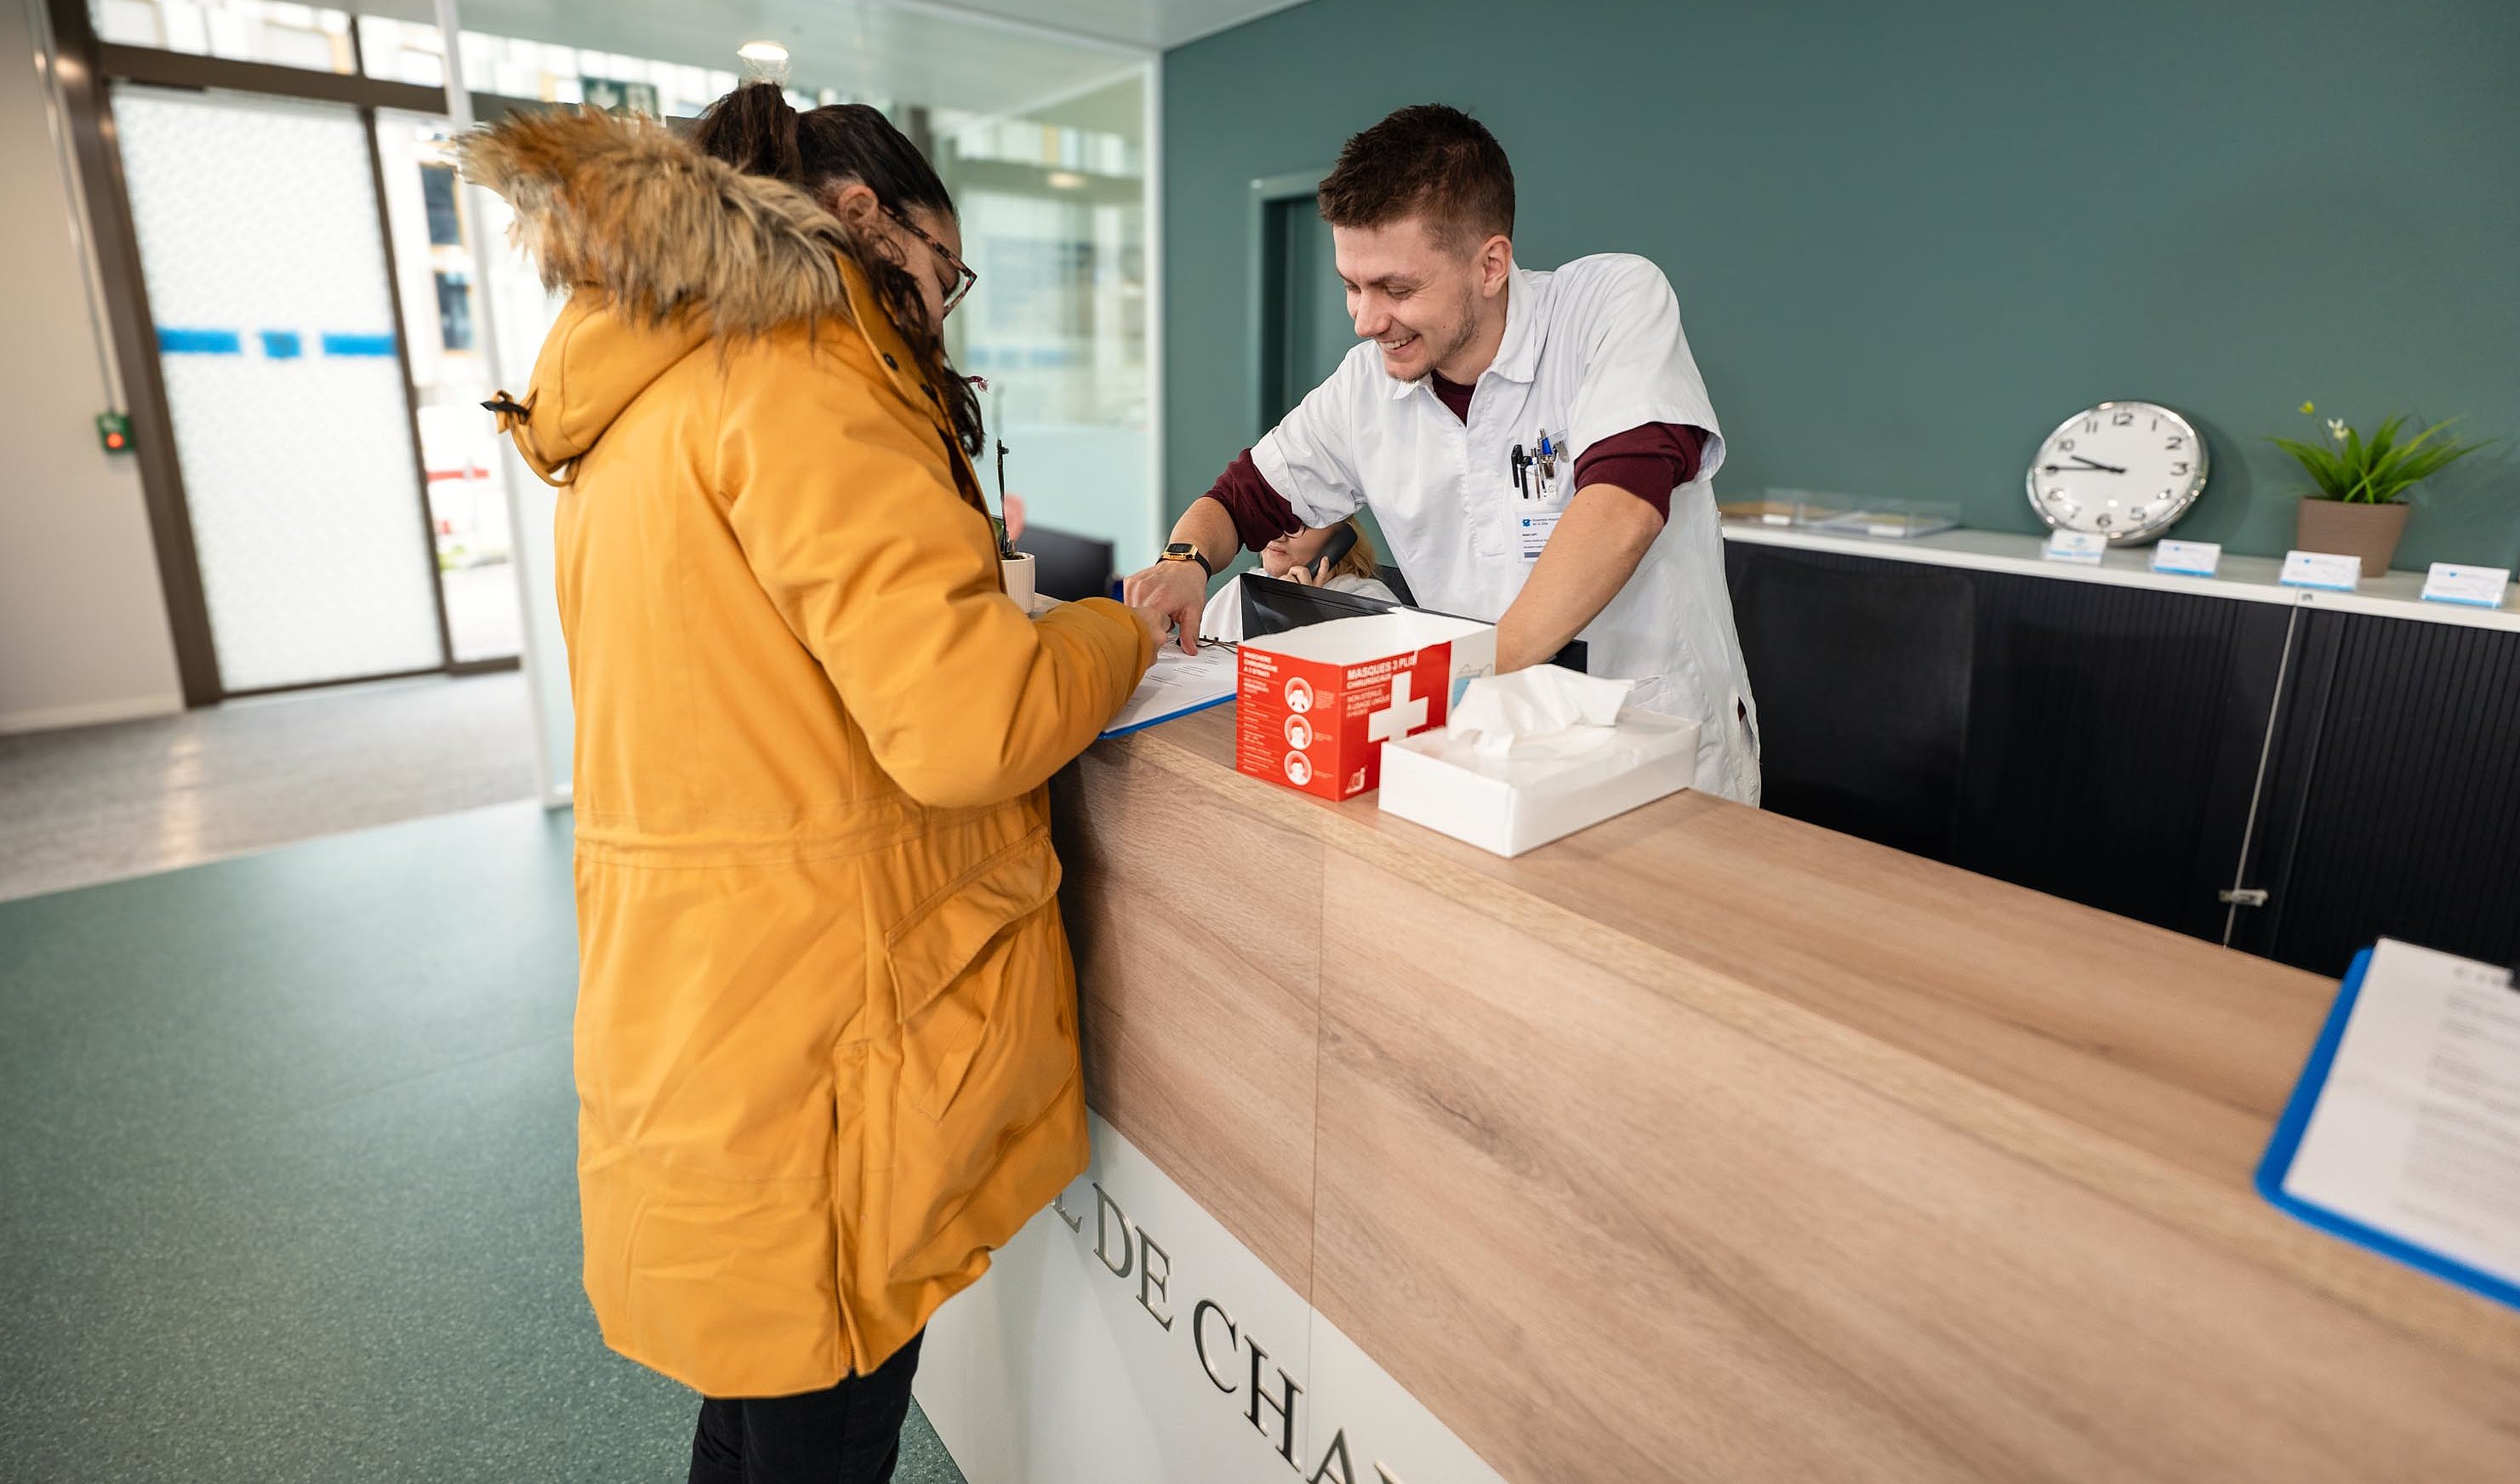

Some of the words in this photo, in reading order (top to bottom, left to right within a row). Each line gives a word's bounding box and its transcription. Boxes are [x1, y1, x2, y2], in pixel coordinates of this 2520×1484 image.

[2112, 412, 2134, 426] 12
[2151, 420, 2158, 432] 1
[2085, 420, 2099, 434] 11
[2058, 438, 2075, 452] 10
[2165, 436, 2183, 451] 2
[2170, 461, 2188, 477] 3
[2095, 513, 2112, 528] 6
[2130, 506, 2147, 521] 5
[1347, 661, 1392, 681] MASQUES
[1092, 1181, 1175, 1332] DE
[1193, 1297, 1404, 1484] CHA
